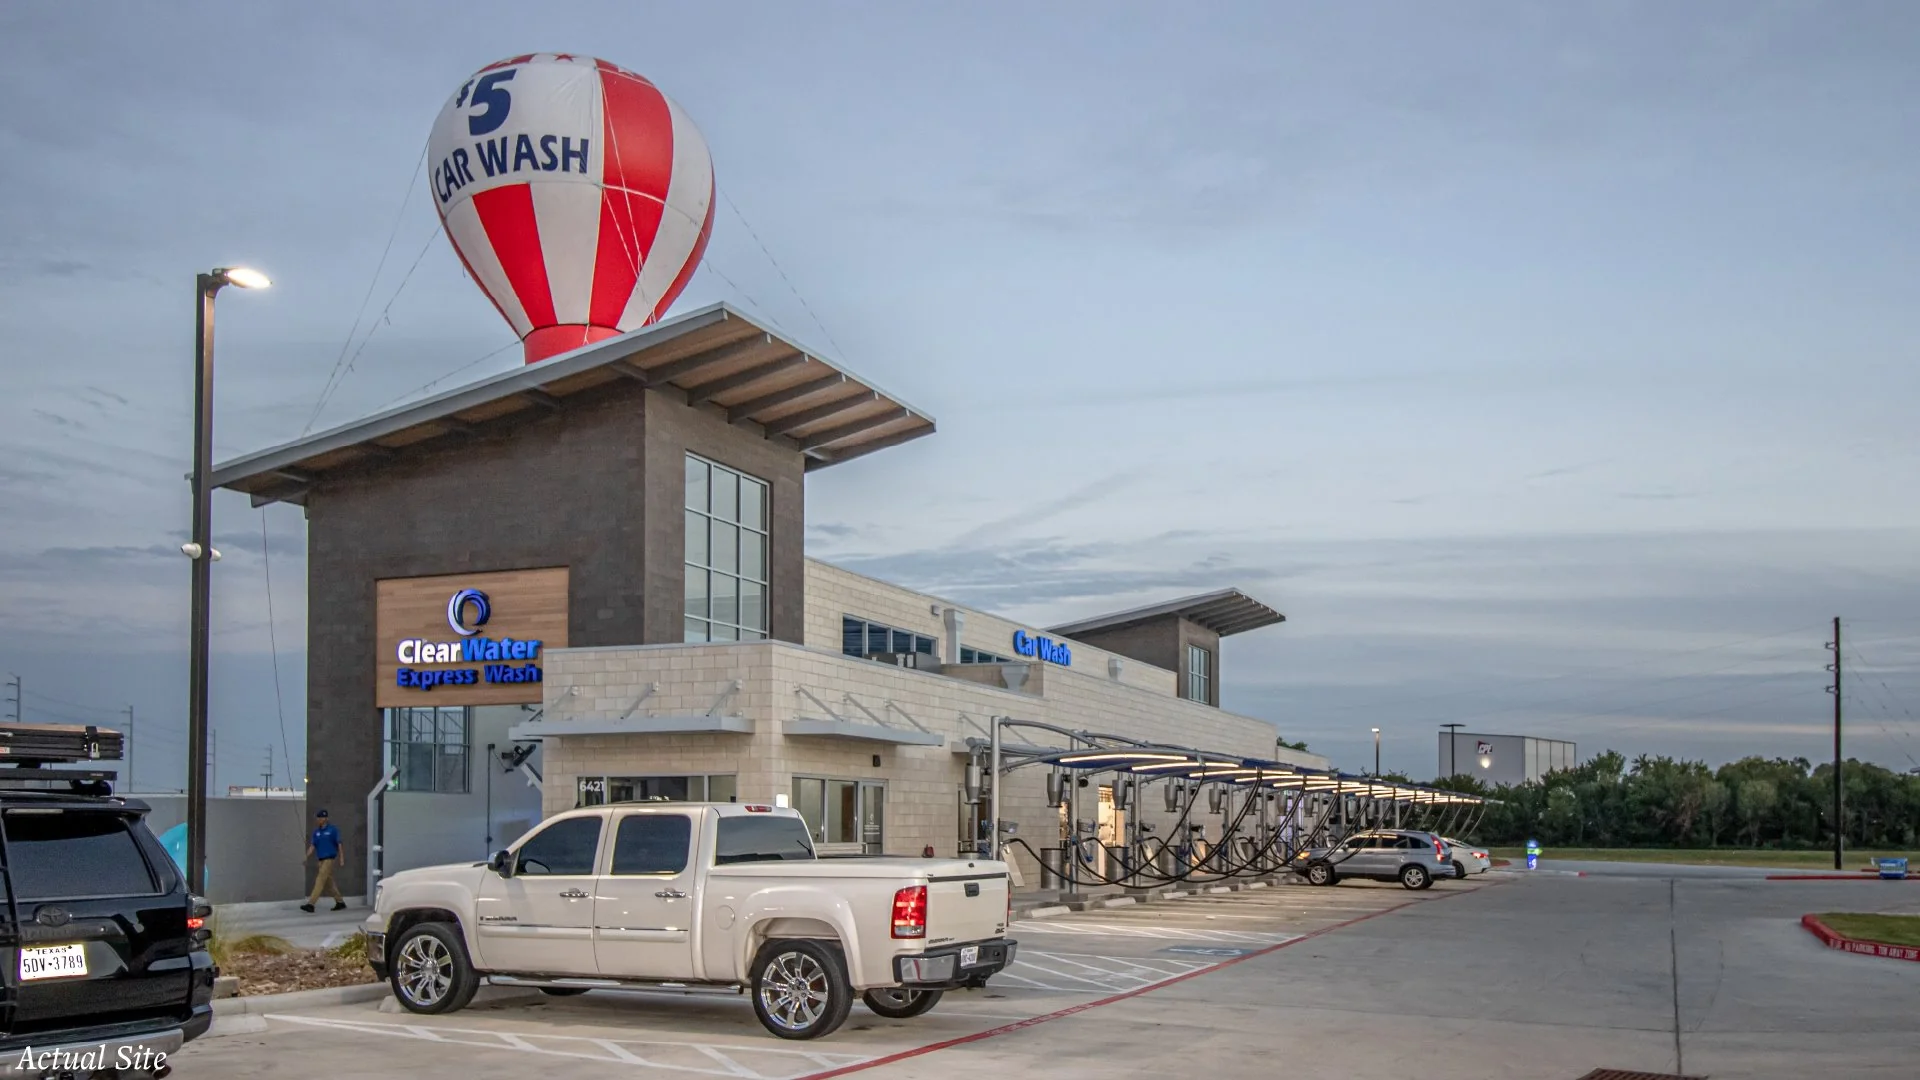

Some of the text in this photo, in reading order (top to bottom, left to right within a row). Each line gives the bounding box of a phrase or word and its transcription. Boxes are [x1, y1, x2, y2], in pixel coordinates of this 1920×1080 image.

[435, 133, 589, 204] CAR WASH
[1013, 629, 1071, 666] Car Wash
[397, 663, 543, 691] Express Wash
[35, 947, 67, 955] TEXAS
[1888, 946, 1904, 957] AWAY
